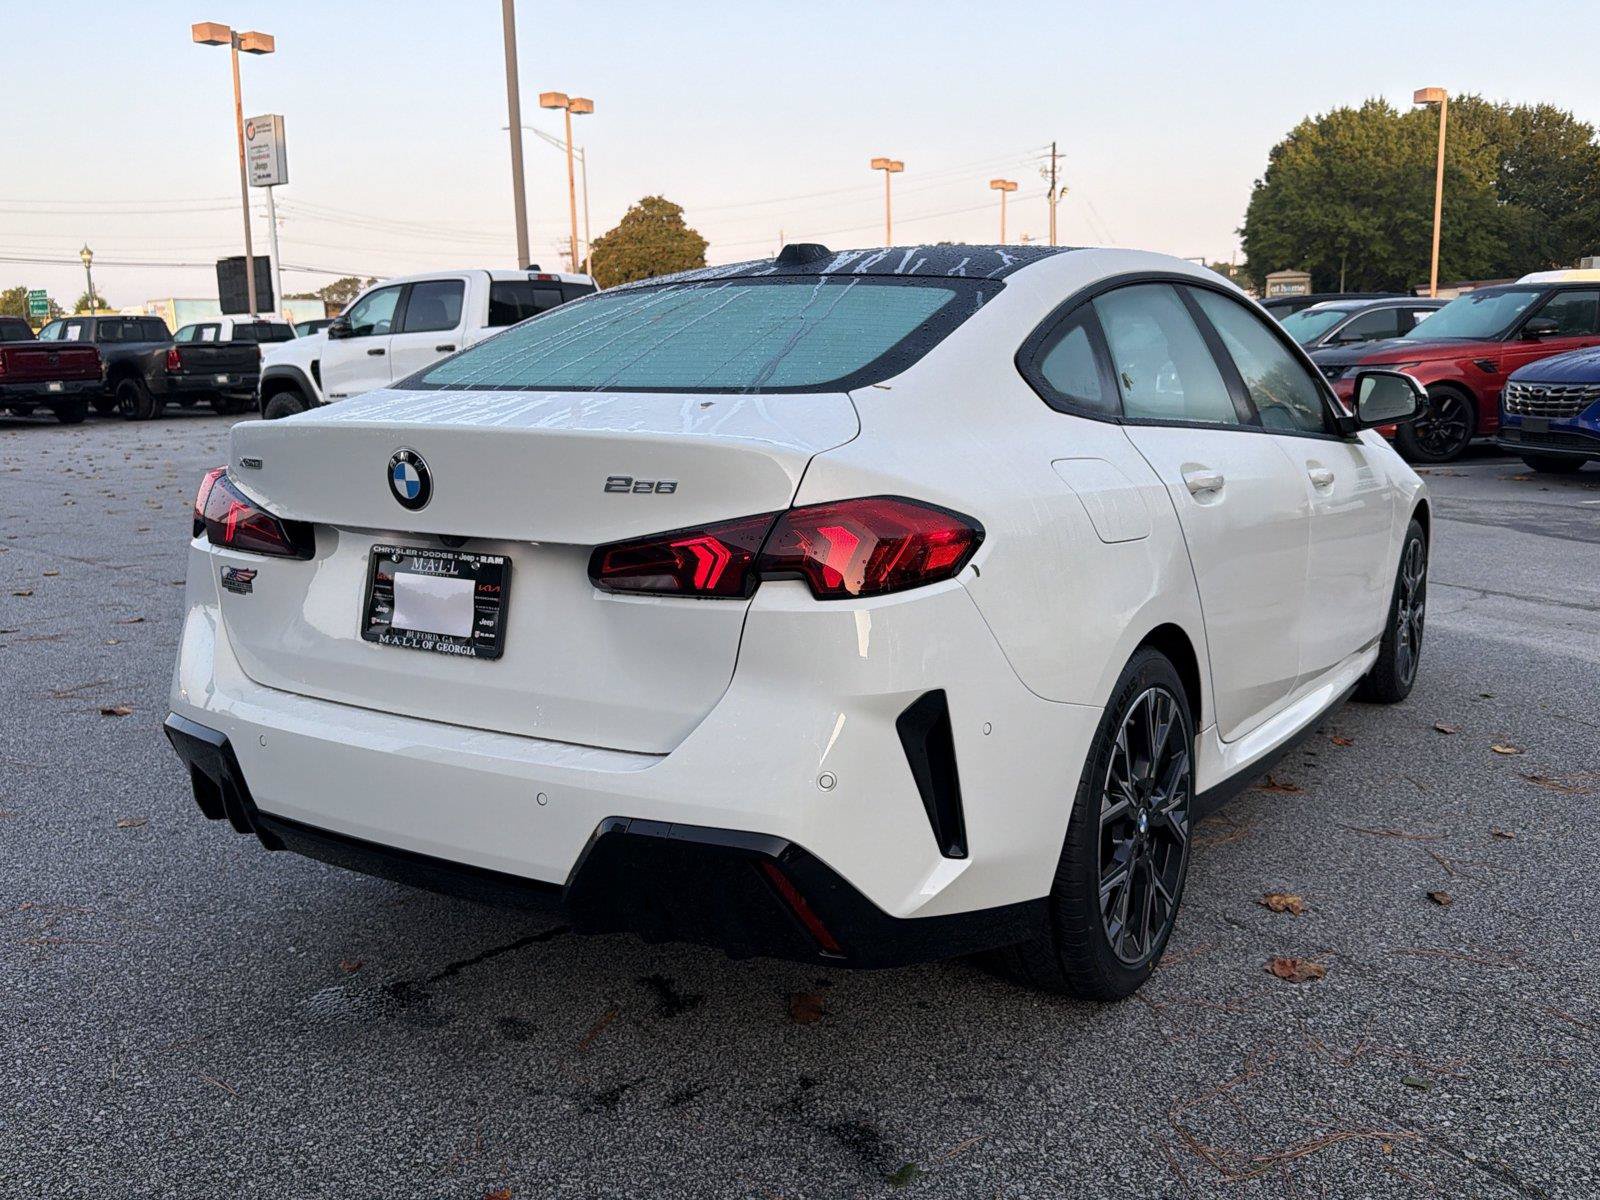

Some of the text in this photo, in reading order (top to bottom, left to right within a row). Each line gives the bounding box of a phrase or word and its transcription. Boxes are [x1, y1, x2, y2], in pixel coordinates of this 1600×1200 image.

[389, 451, 426, 472] BMW
[604, 475, 678, 494] 228
[373, 546, 504, 565] CHRYSLER DODGE Jeep RAM
[479, 618, 495, 627] Jeep
[422, 639, 435, 650] OF
[436, 642, 476, 656] GEORGIA
